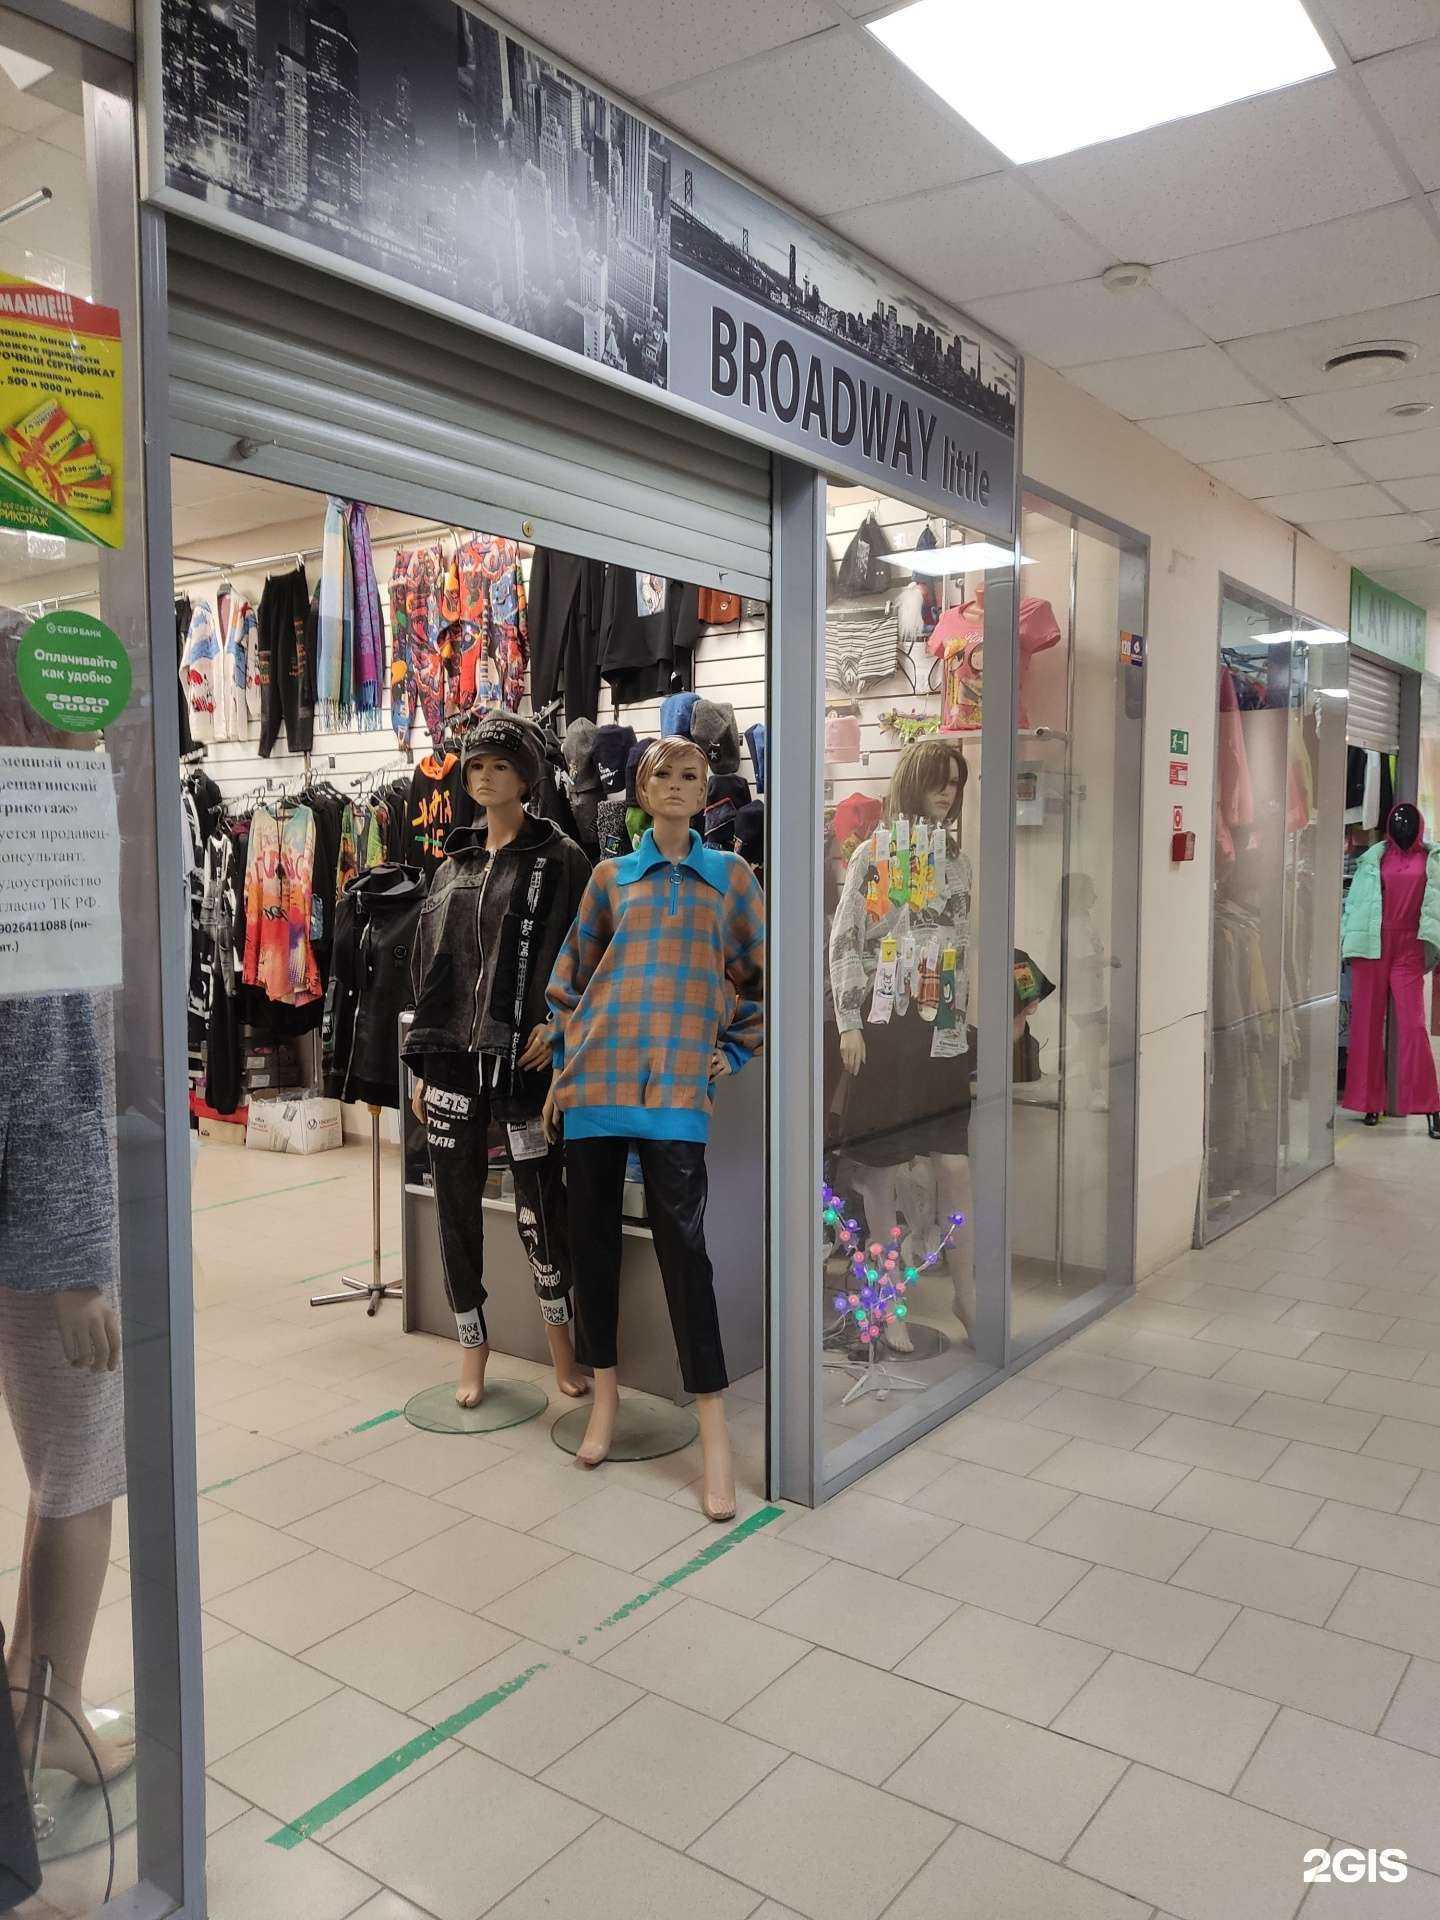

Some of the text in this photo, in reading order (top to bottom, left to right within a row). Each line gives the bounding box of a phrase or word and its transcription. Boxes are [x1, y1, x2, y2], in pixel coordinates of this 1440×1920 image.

[39, 335, 87, 351] магазие
[46, 359, 116, 378] СЕРТИФИКАТ
[40, 381, 62, 393] 1000
[710, 304, 990, 508] BROADWAY little
[34, 648, 118, 670] Оплачивайте
[41, 668, 113, 684] как удобно
[50, 896, 70, 910] ТК
[424, 1085, 470, 1114] MEETS
